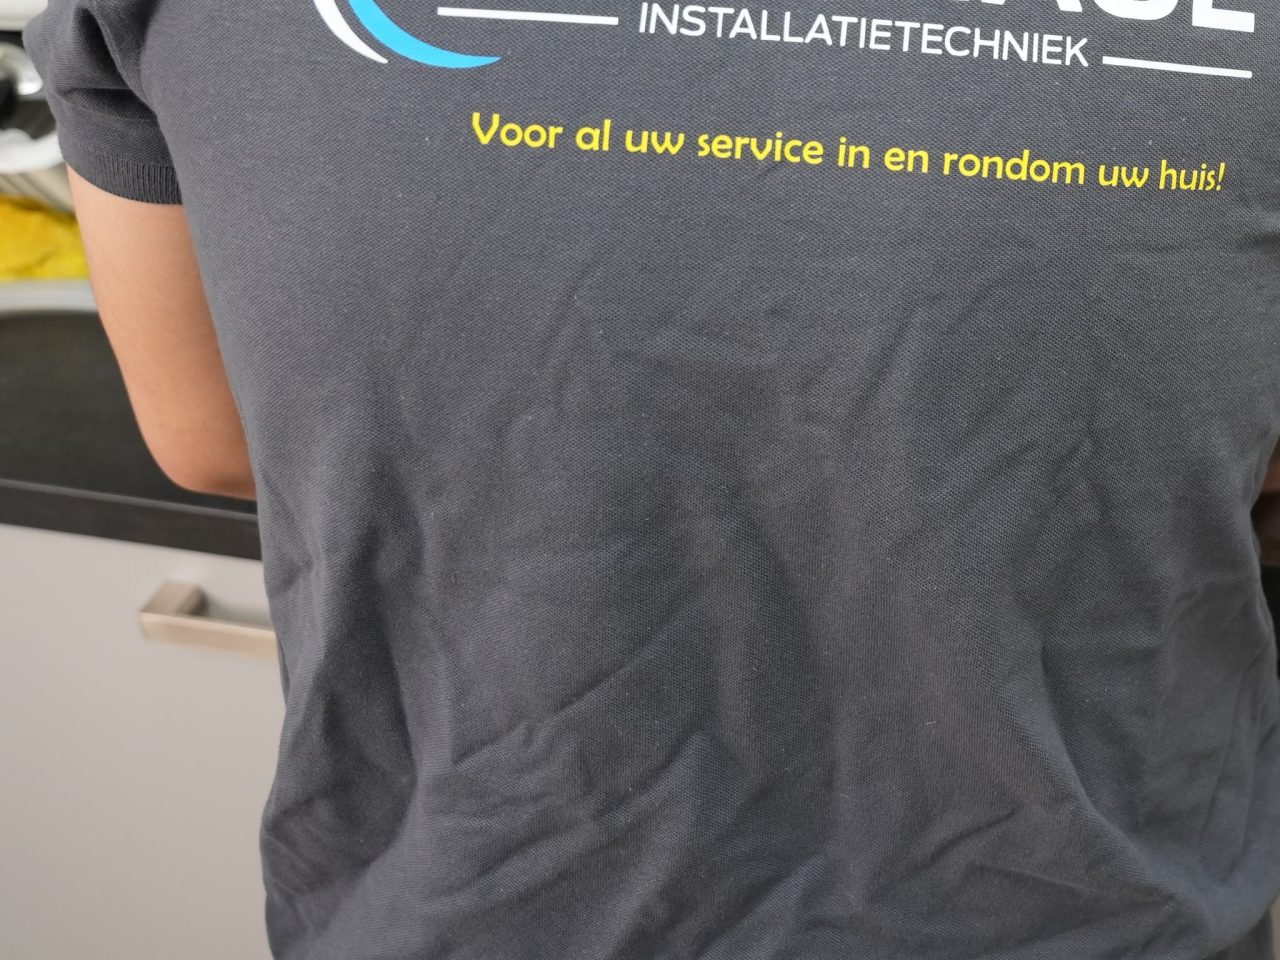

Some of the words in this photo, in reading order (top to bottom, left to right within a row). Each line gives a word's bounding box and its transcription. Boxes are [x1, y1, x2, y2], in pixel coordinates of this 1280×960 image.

[638, 1, 1089, 68] INSTALLATIETECHNIEK
[470, 111, 563, 149] Voor
[575, 118, 613, 152] al
[624, 129, 686, 155] uw
[697, 131, 824, 164] service
[836, 136, 871, 168] in
[883, 146, 929, 173] en
[943, 149, 1085, 185] rondom
[1097, 165, 1150, 189] uw
[1158, 159, 1226, 192] huis!
